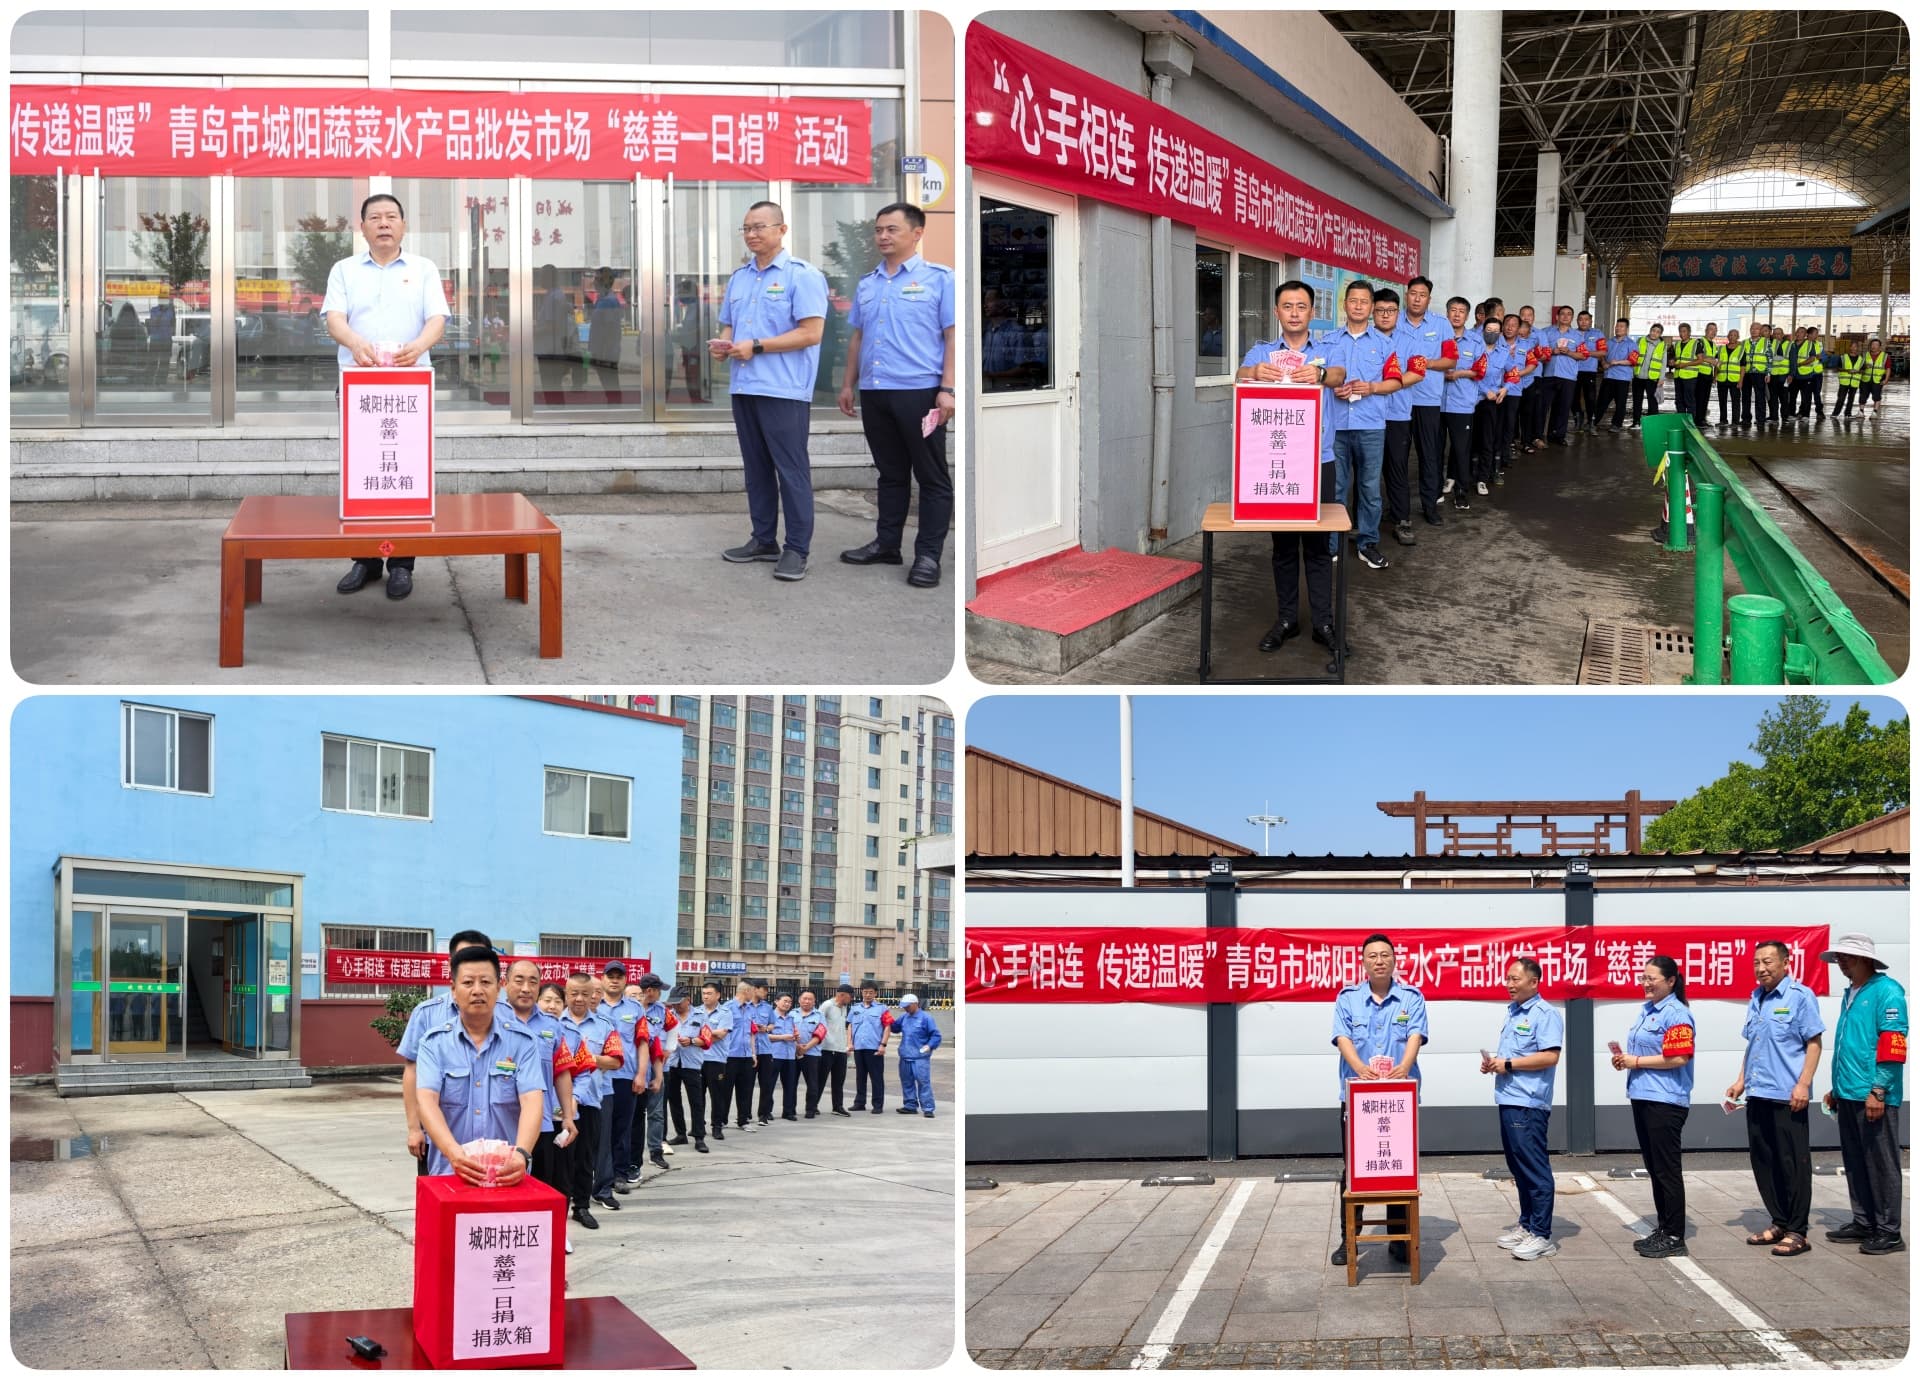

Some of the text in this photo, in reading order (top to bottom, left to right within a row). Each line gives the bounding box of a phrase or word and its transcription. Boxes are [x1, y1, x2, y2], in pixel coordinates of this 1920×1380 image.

[359, 394, 418, 414] 城阳村社区
[1250, 407, 1306, 426] 城阳村社区
[379, 417, 399, 473] 慈善一日捐
[1269, 429, 1287, 479] 慈善一日捐
[363, 475, 414, 490] 捐款箱
[1253, 482, 1300, 496] 捐款箱
[1361, 1099, 1406, 1114] 城阳村社区
[1377, 1116, 1391, 1157] 慈善一日捐
[1365, 1159, 1403, 1171] 捐款箱
[469, 1224, 540, 1251] 城阳村社区
[491, 1254, 516, 1323] 慈善一日捐
[471, 1326, 533, 1348] 捐款箱
